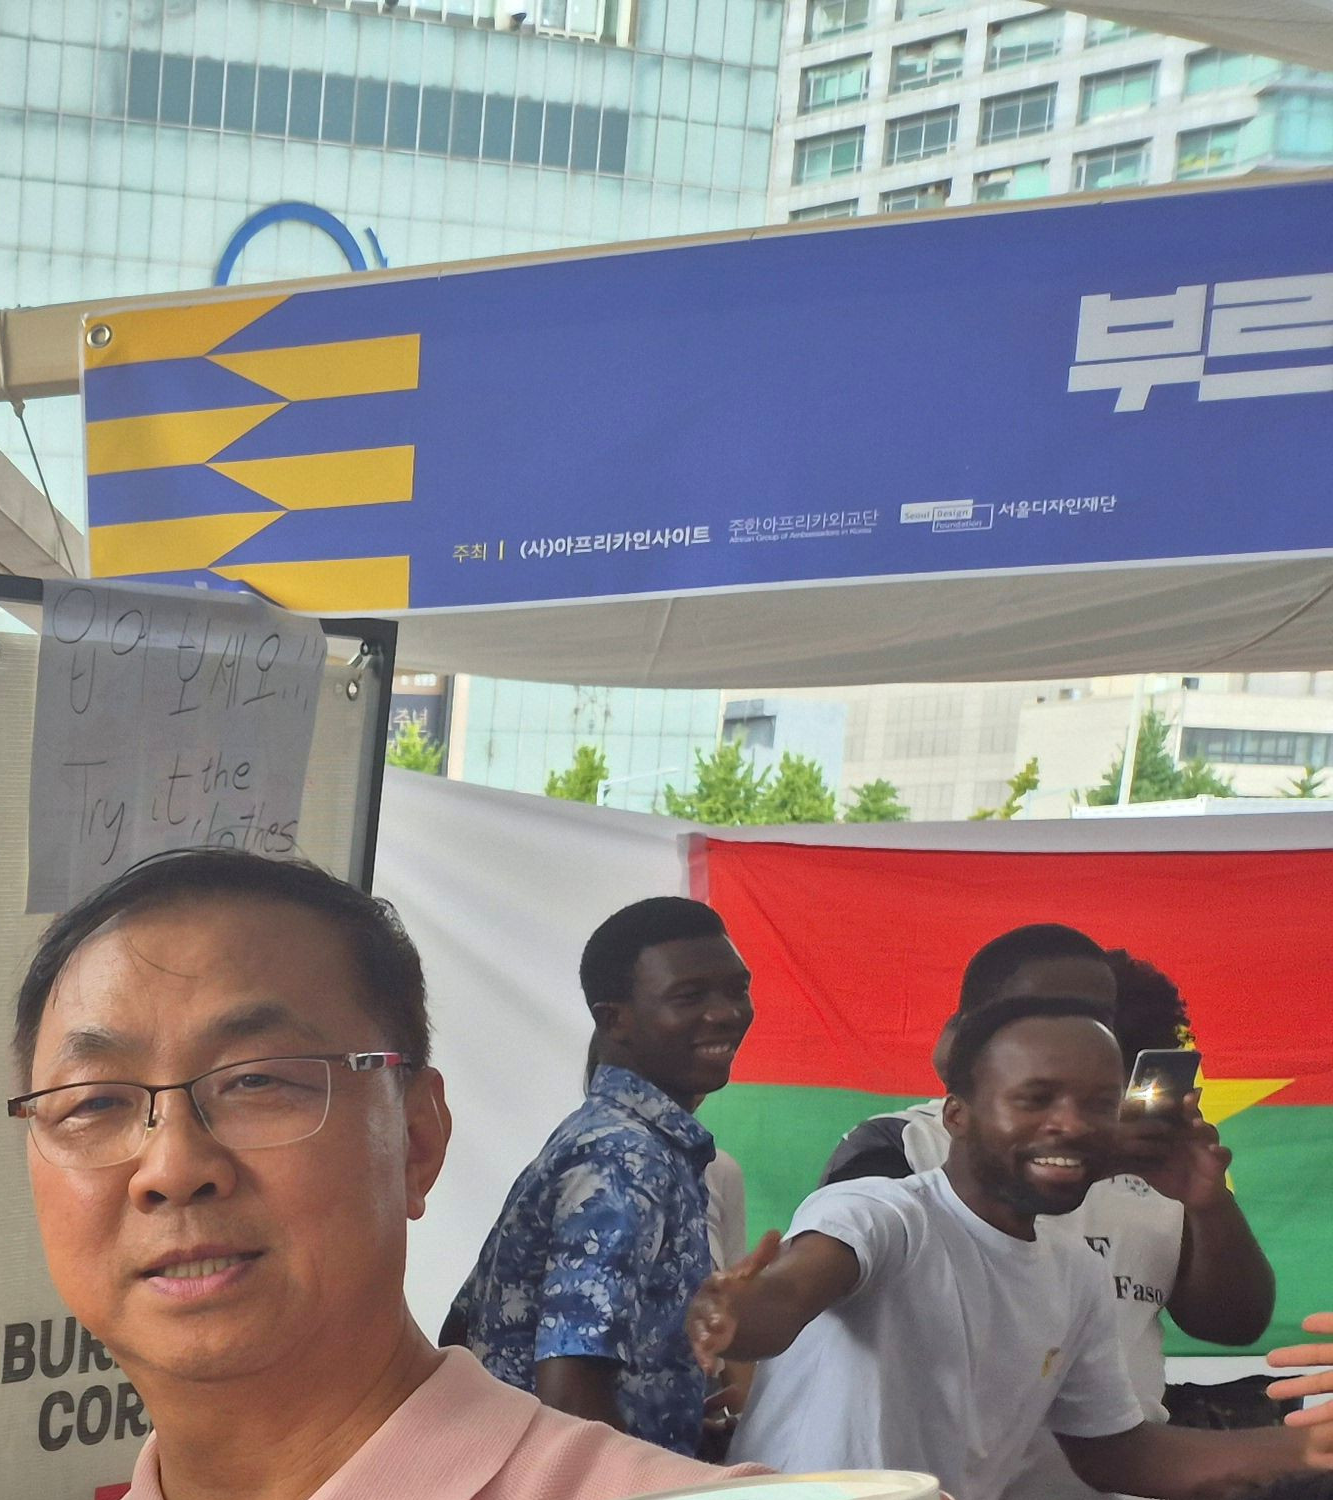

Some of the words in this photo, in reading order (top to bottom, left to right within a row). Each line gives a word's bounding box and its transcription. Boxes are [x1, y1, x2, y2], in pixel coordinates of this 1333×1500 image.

[998, 495, 1117, 518] 서울디자인재단
[452, 542, 488, 564] 주최
[519, 525, 712, 560] (사)아프리카인사이트
[63, 760, 126, 866] Try
[201, 751, 252, 793] the
[1113, 1275, 1163, 1305] Faso
[0, 1316, 121, 1385] BUR
[38, 1382, 153, 1452] COR
